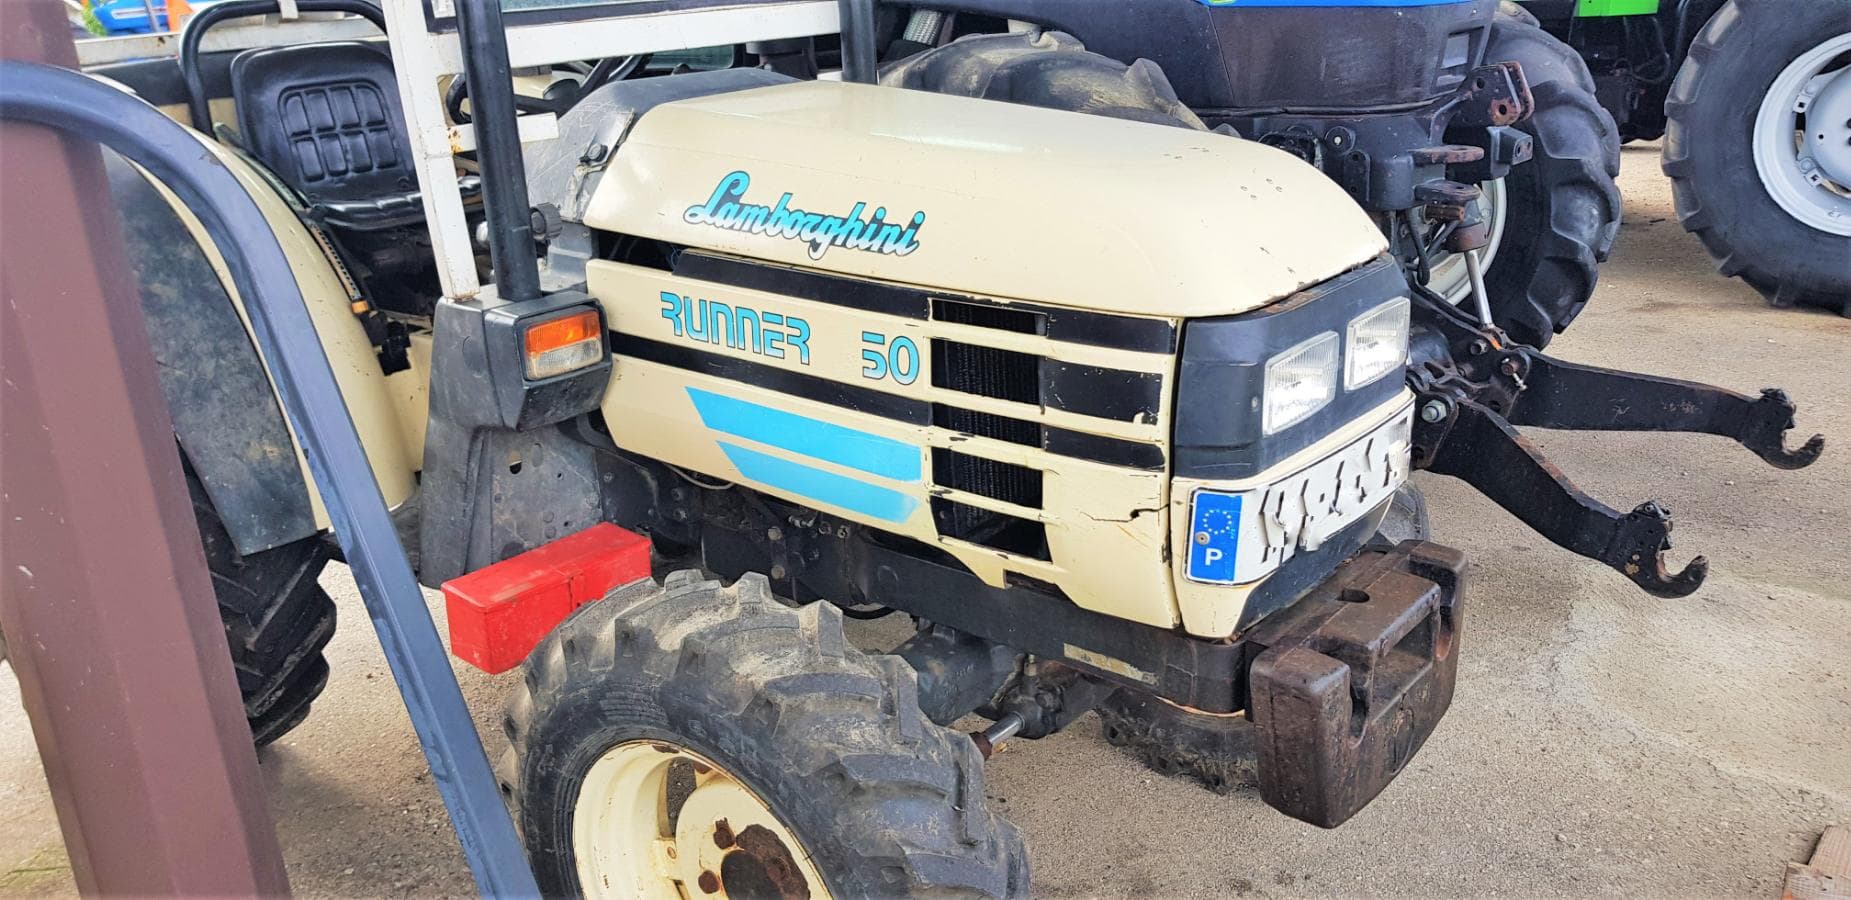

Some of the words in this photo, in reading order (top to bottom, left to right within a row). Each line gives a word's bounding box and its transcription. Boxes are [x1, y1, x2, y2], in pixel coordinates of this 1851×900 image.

[683, 170, 926, 260] Lamborghini
[660, 291, 811, 366] RUNNER
[862, 331, 920, 386] 50
[1204, 547, 1223, 566] P
